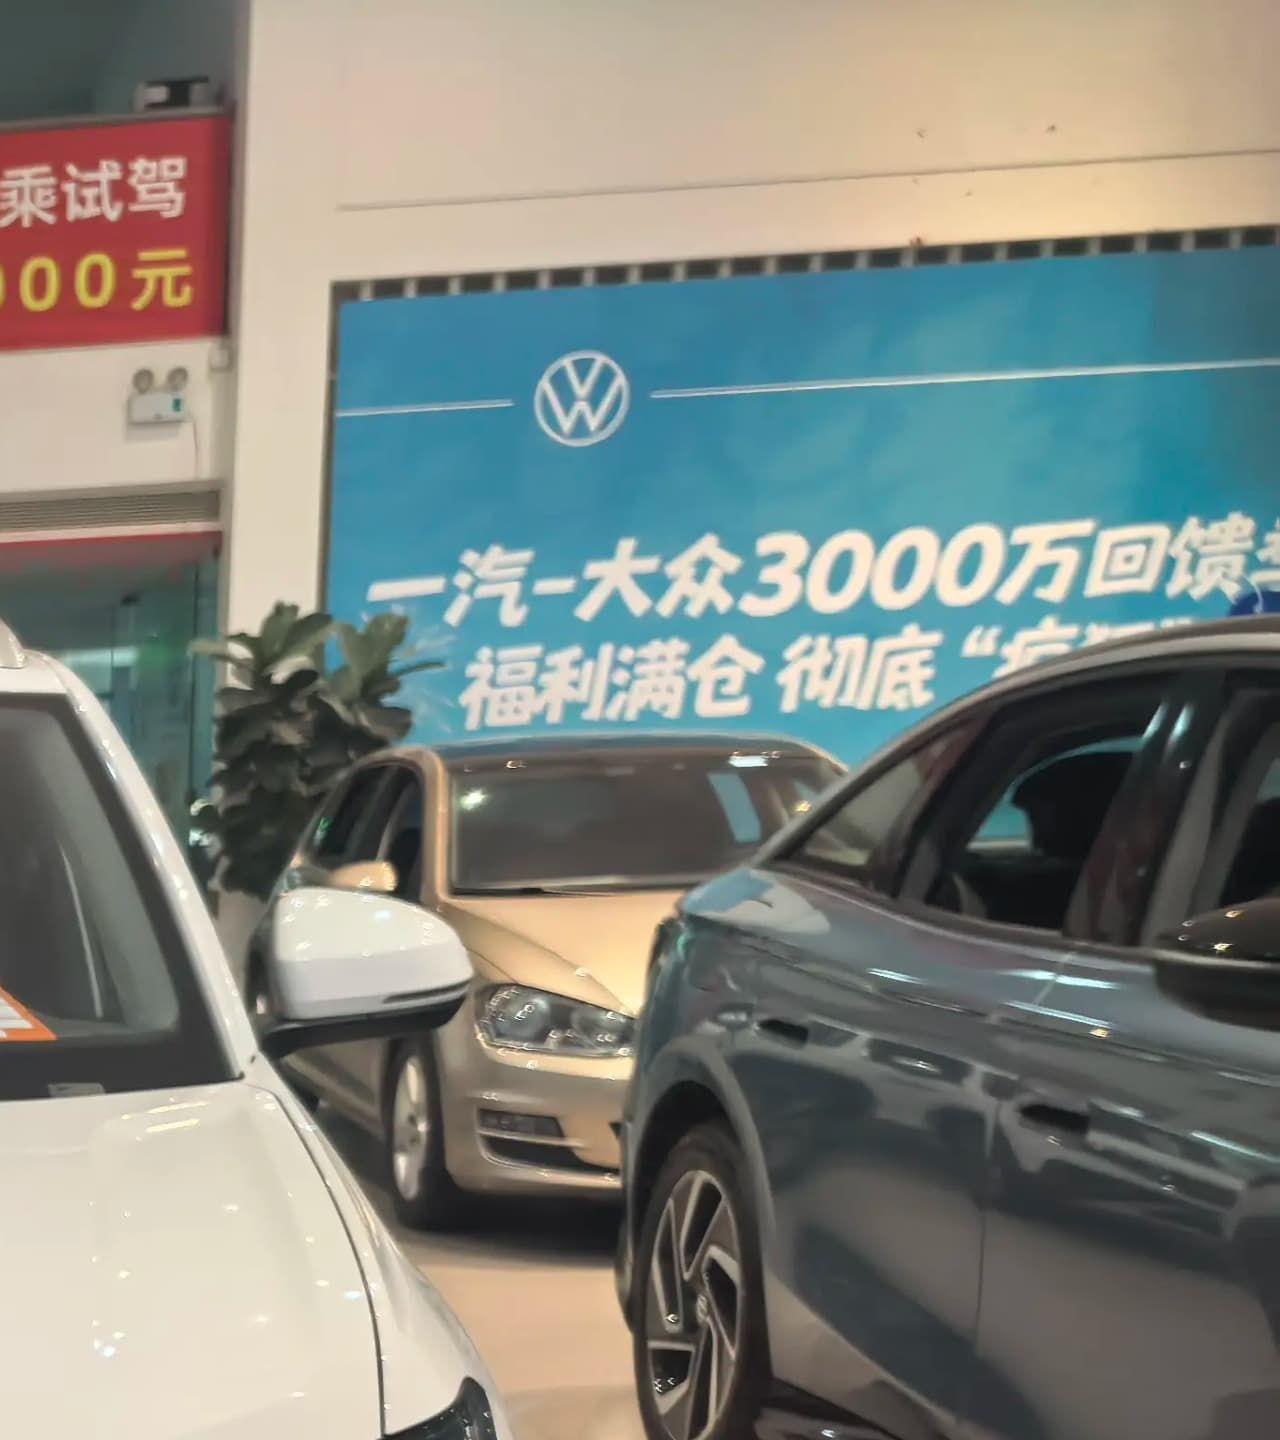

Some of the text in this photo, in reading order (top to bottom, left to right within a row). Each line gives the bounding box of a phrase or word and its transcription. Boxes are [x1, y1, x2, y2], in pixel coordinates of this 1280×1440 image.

[458, 633, 767, 732] 福利满仓
[776, 623, 942, 714] 彻底
